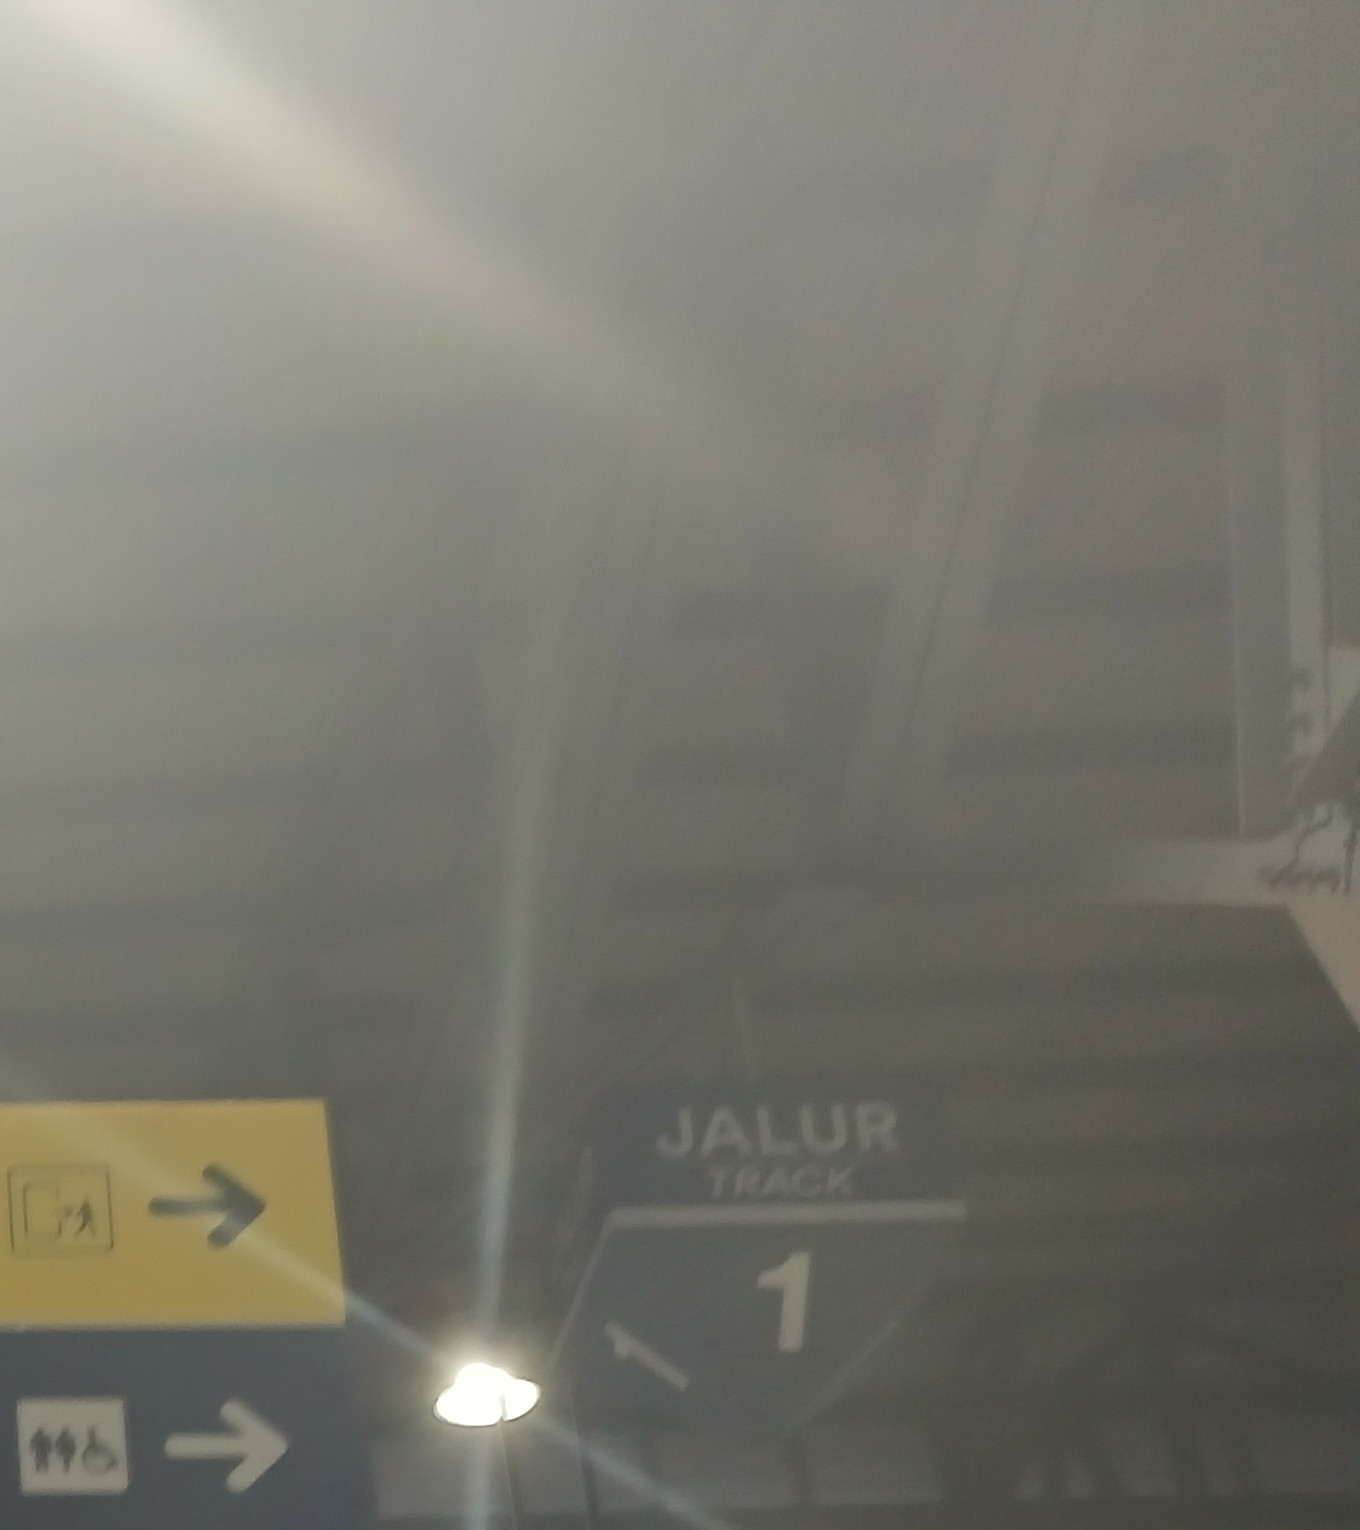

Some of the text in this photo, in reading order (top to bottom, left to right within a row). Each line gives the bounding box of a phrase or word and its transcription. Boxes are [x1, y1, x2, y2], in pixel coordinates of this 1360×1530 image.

[655, 1102, 902, 1158] JALUR
[707, 1165, 854, 1199] TRACK
[756, 1250, 811, 1353] 1
